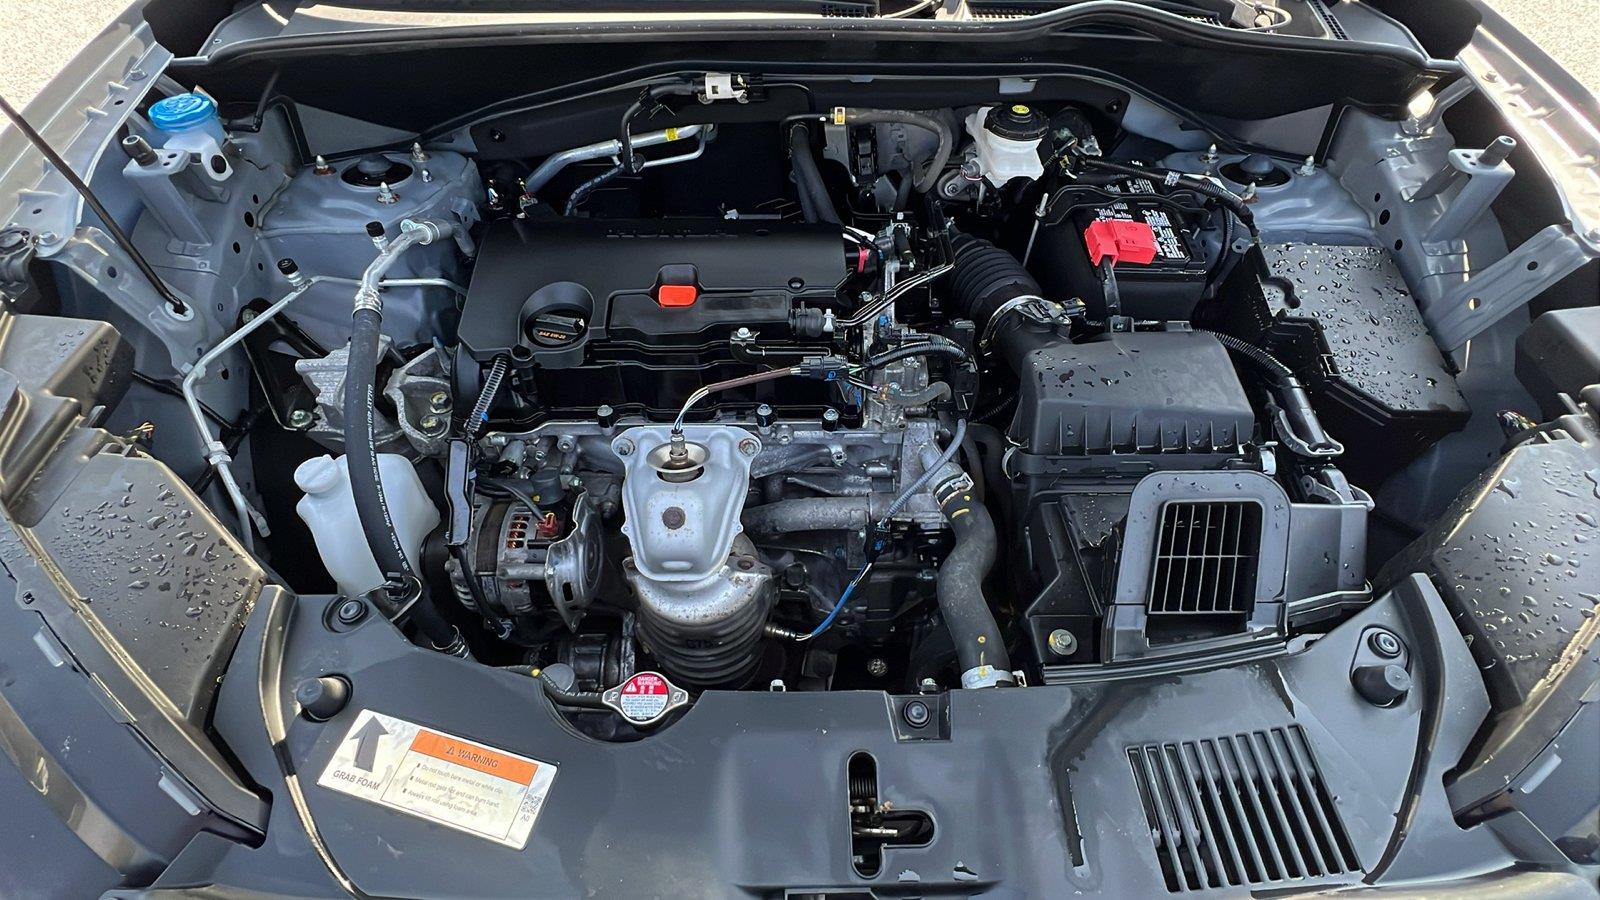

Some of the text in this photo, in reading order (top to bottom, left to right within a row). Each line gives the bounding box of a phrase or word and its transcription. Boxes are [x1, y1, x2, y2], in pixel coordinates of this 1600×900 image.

[457, 749, 499, 768] WARNING
[333, 770, 380, 790] GRAB FOAM
[415, 776, 428, 786] Metal
[436, 784, 448, 792] gets
[438, 769, 450, 777] touch
[450, 773, 462, 781] bare
[462, 777, 476, 786] metal
[408, 790, 424, 800] Always
[440, 801, 453, 810] using
[454, 804, 466, 812] foam
